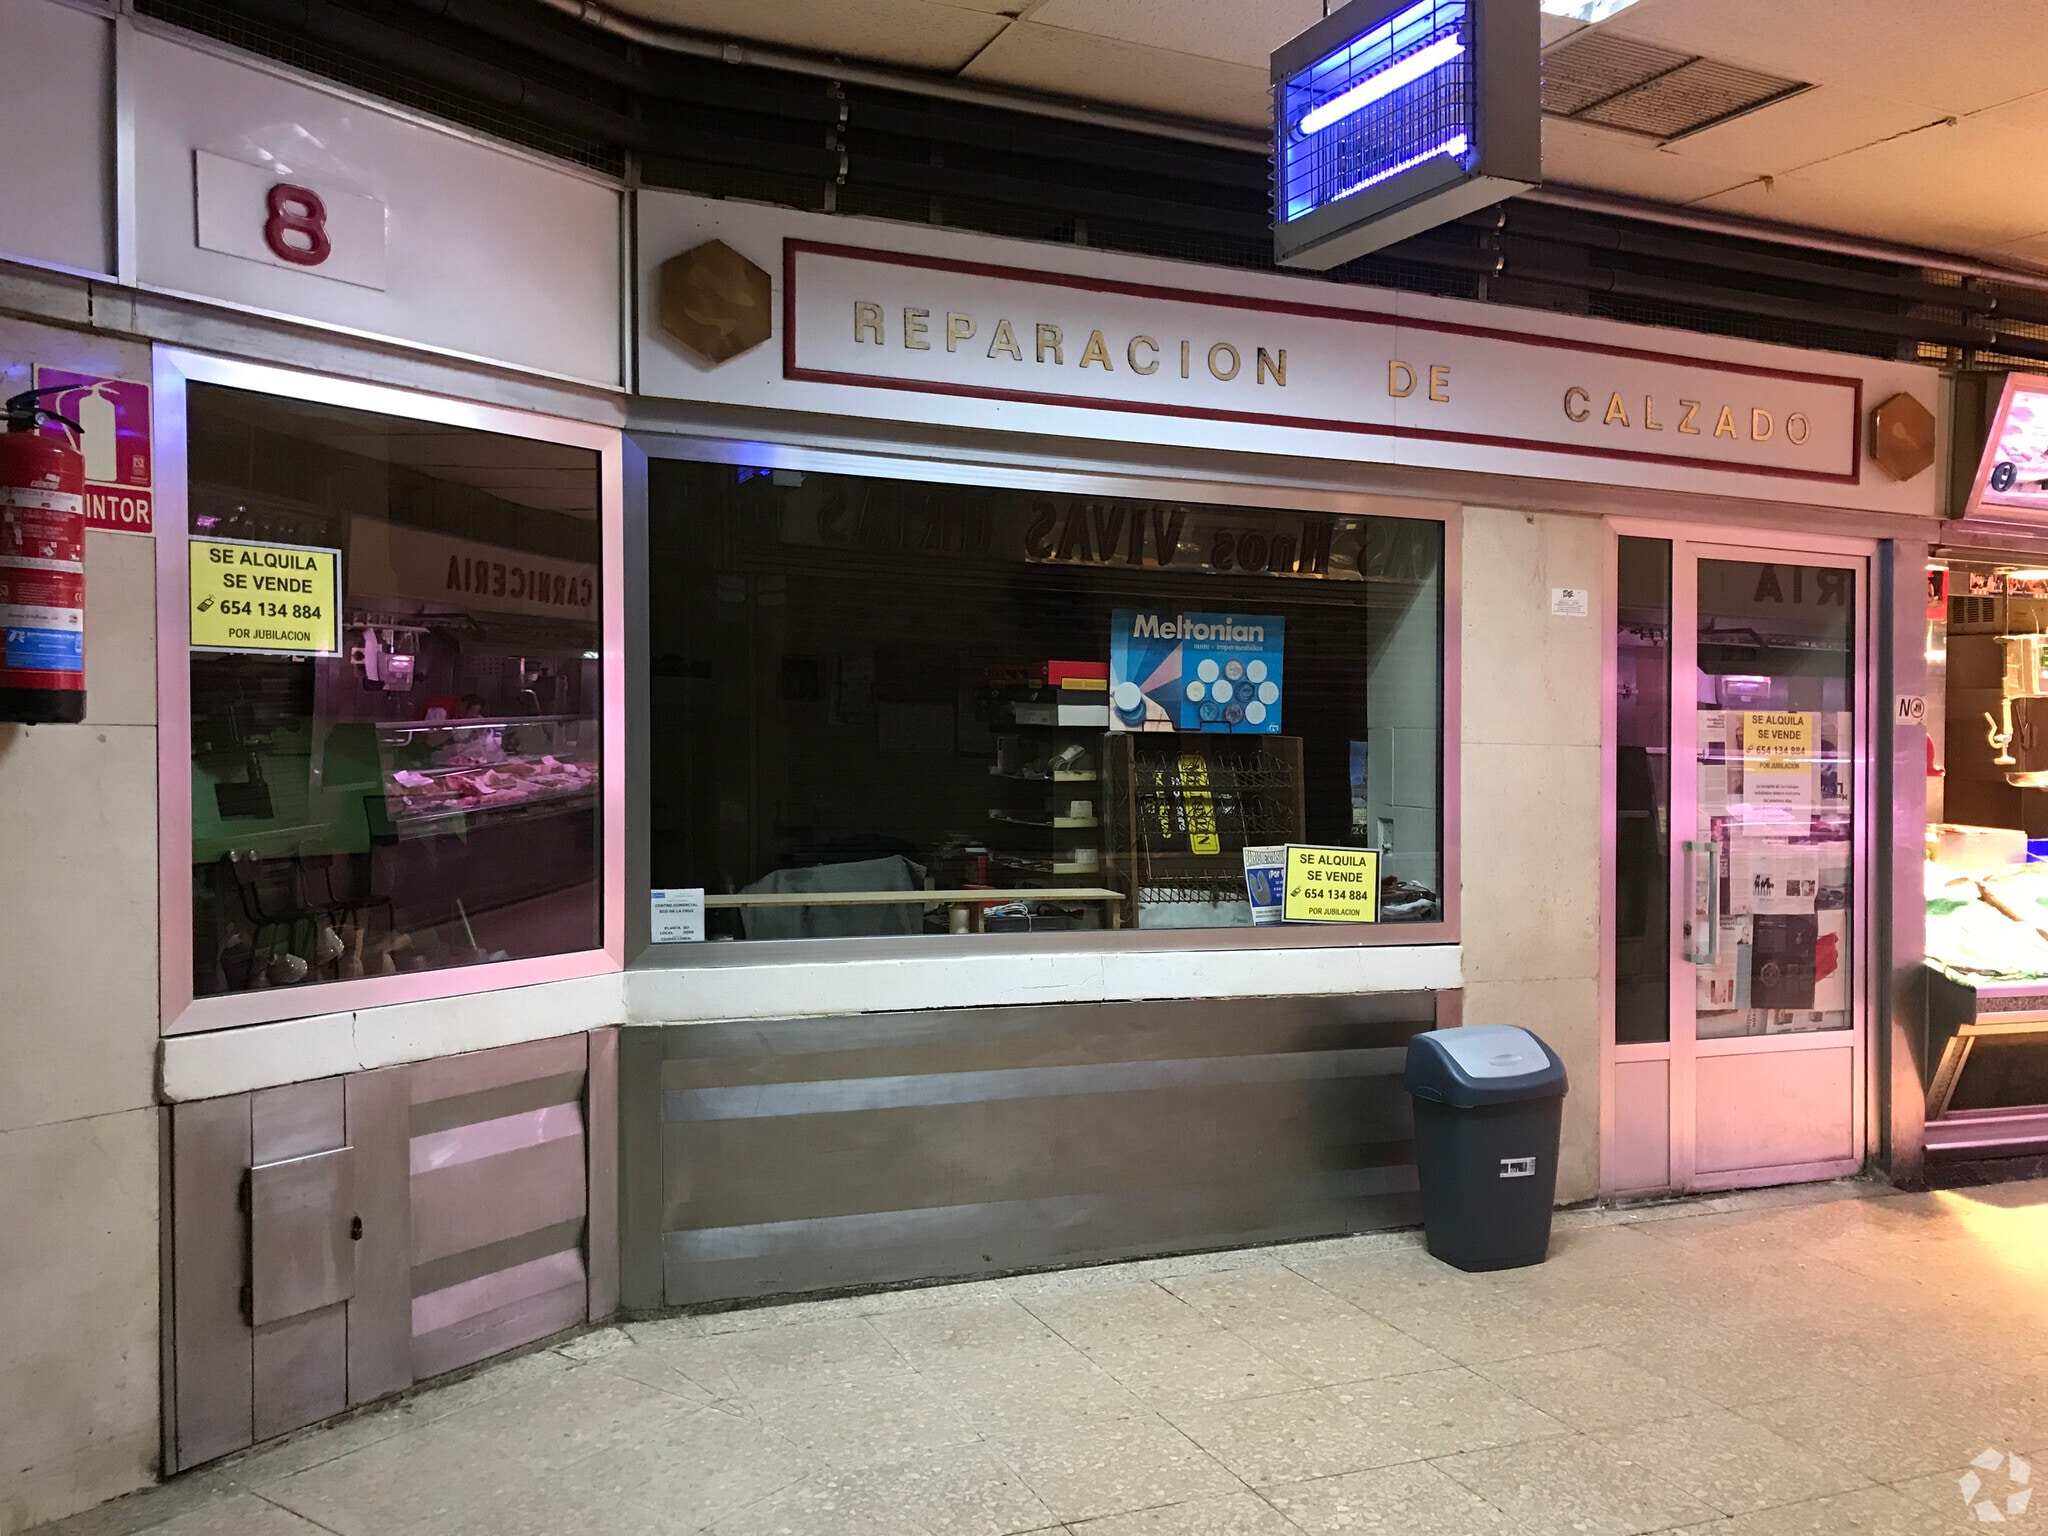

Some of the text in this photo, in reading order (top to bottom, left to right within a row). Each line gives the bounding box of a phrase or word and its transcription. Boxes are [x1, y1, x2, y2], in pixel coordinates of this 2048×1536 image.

[265, 183, 331, 266] 8
[854, 301, 1811, 446] REPARACION DE CALZADO
[86, 493, 150, 524] INTOR
[209, 548, 318, 571] SE ALQUILA
[223, 573, 313, 594] SE VENDE
[220, 600, 322, 620] 654 134 884
[229, 628, 311, 641] POR JUBILACION
[1133, 614, 1264, 643] Meltonian
[1752, 715, 1804, 726] SE ALQUILA
[1758, 729, 1801, 740] SE VENDE
[1756, 745, 1805, 756] 654 134 884
[1771, 762, 1800, 770] JUBILACION
[1299, 853, 1366, 867] SE ALQUILA
[1307, 870, 1363, 883] SE VENDE
[1304, 888, 1368, 901] 654 134 884
[1309, 907, 1360, 916] POR JUBILACION
